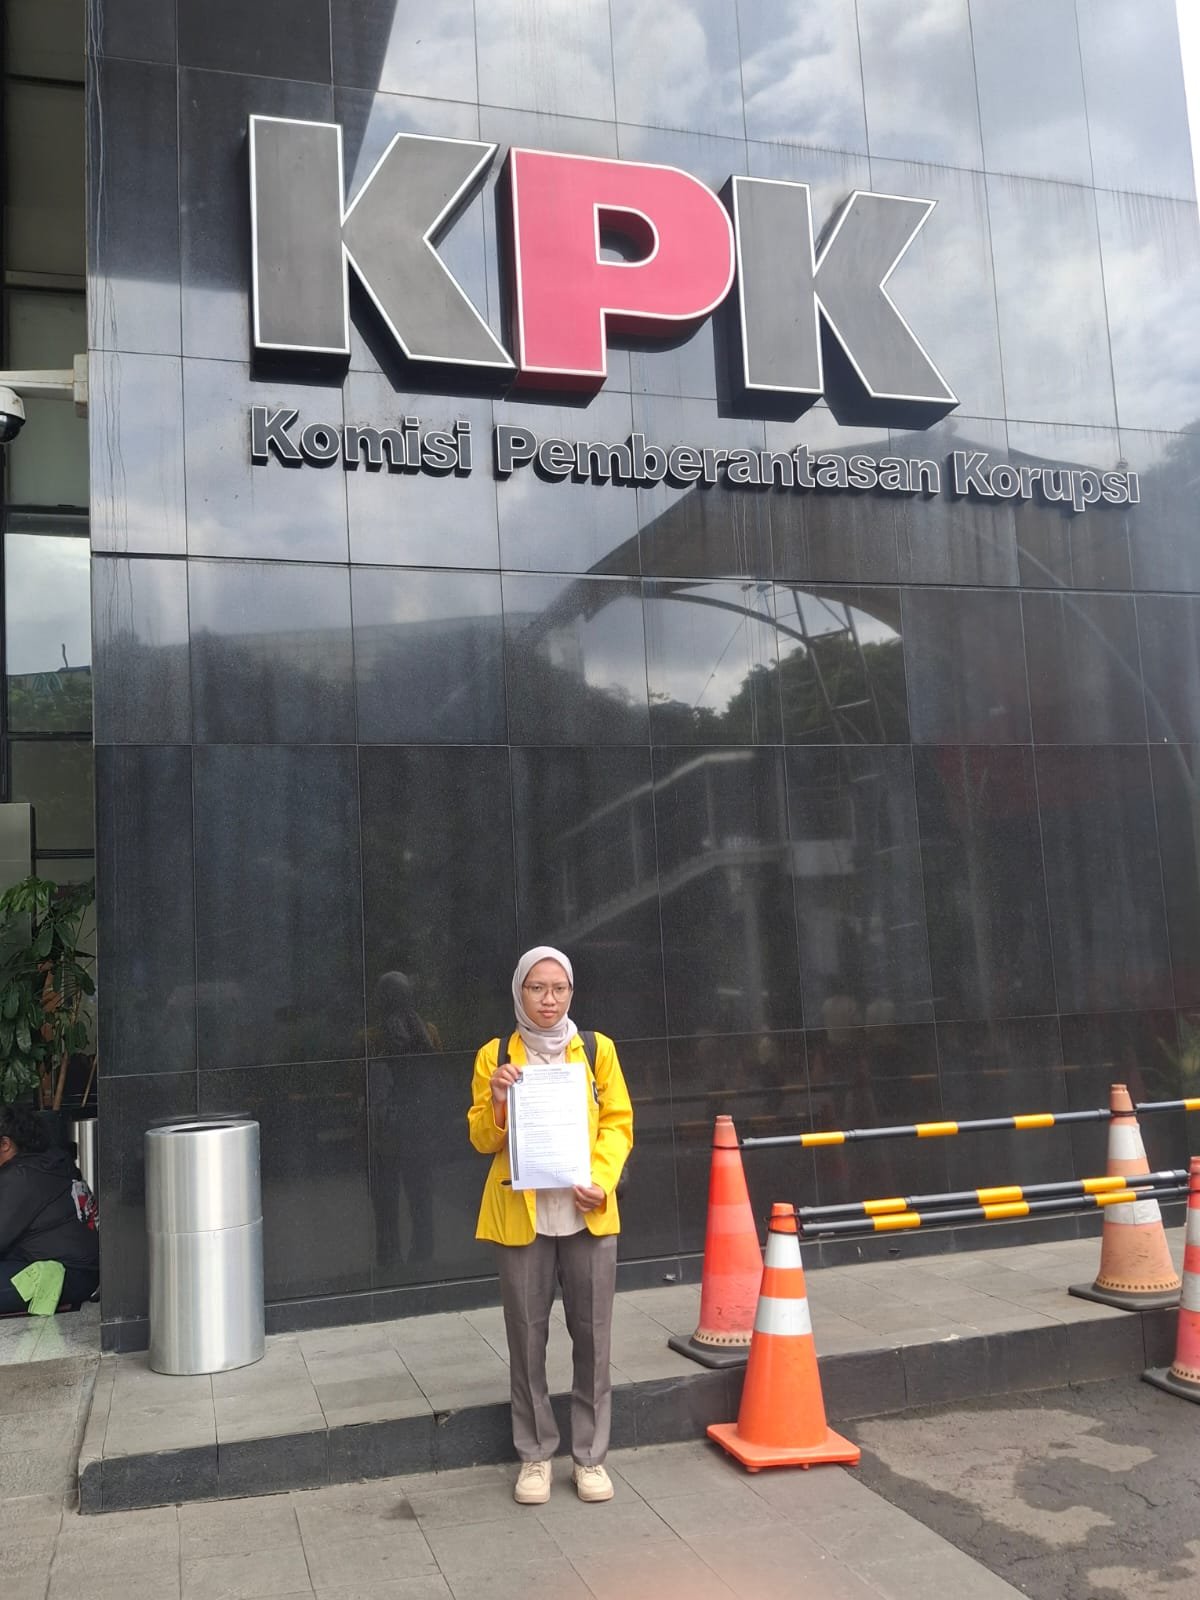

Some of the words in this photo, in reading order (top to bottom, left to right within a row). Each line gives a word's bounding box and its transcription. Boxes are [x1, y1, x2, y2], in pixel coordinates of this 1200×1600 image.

[248, 114, 960, 407] KPK
[251, 406, 473, 470] Komisi
[496, 424, 941, 494] Pemberantasan
